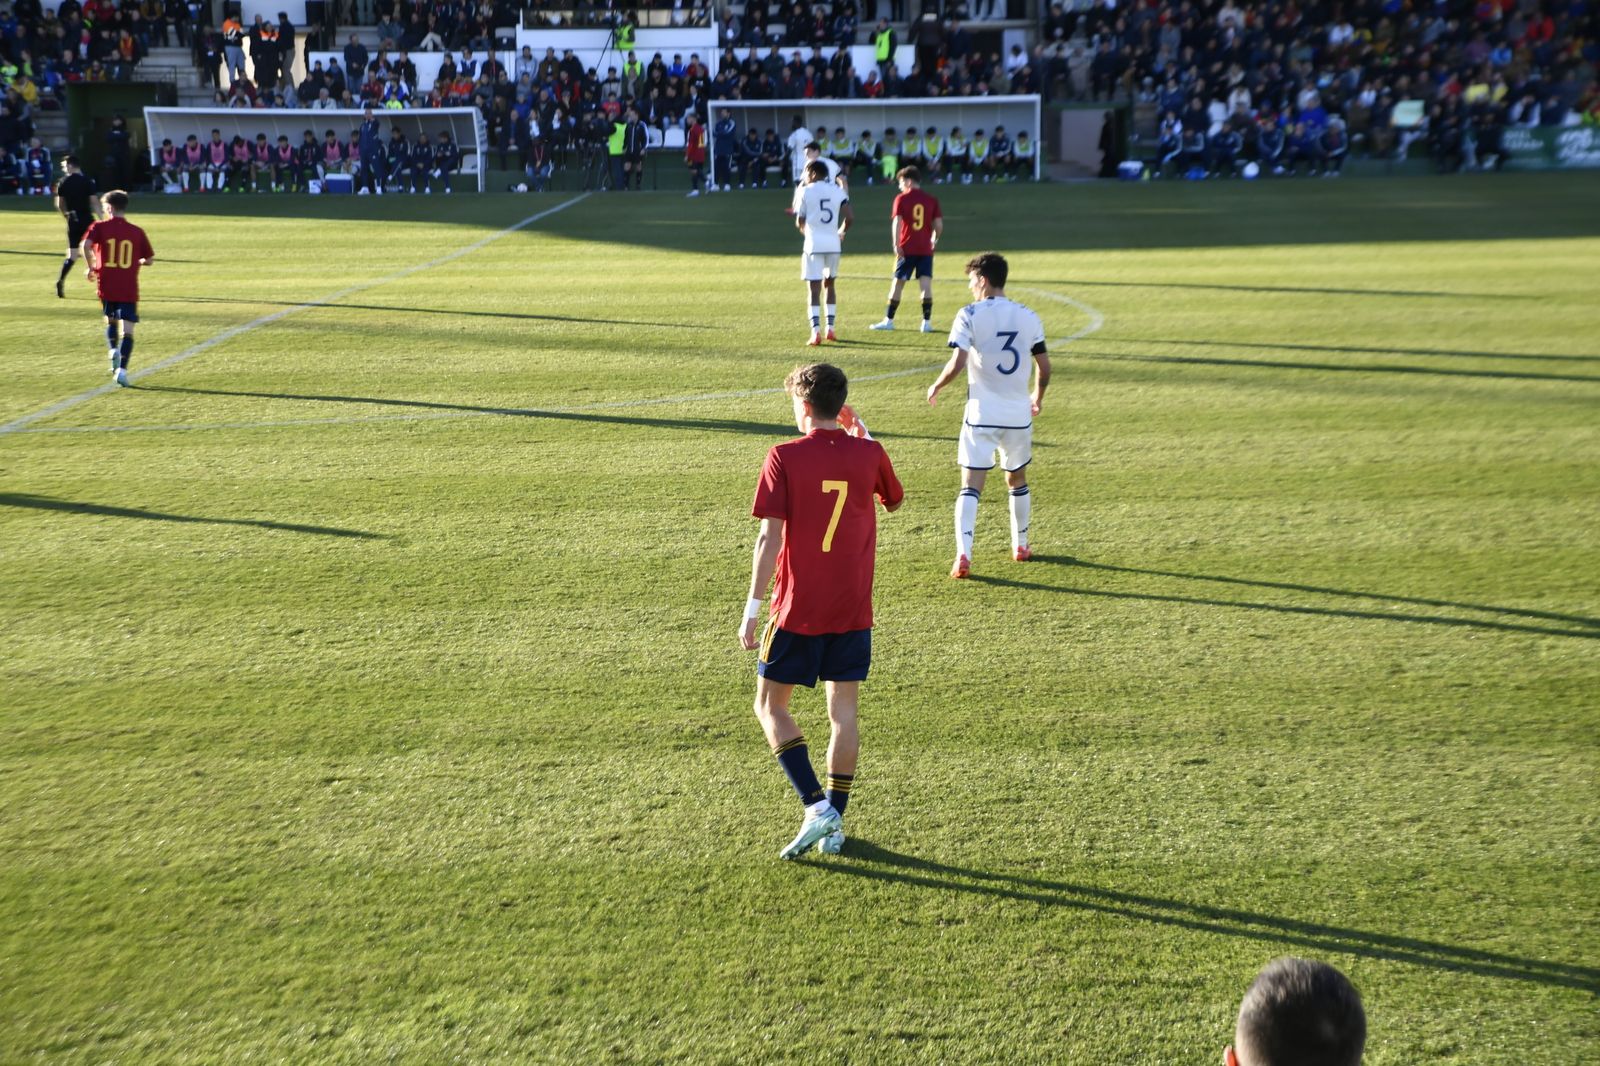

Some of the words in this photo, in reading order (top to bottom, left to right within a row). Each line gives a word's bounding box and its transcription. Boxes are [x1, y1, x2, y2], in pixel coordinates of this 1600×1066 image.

[820, 199, 833, 224] 5
[912, 203, 925, 231] 9
[104, 238, 133, 269] 10
[996, 331, 1020, 375] 3
[822, 480, 848, 552] 7
